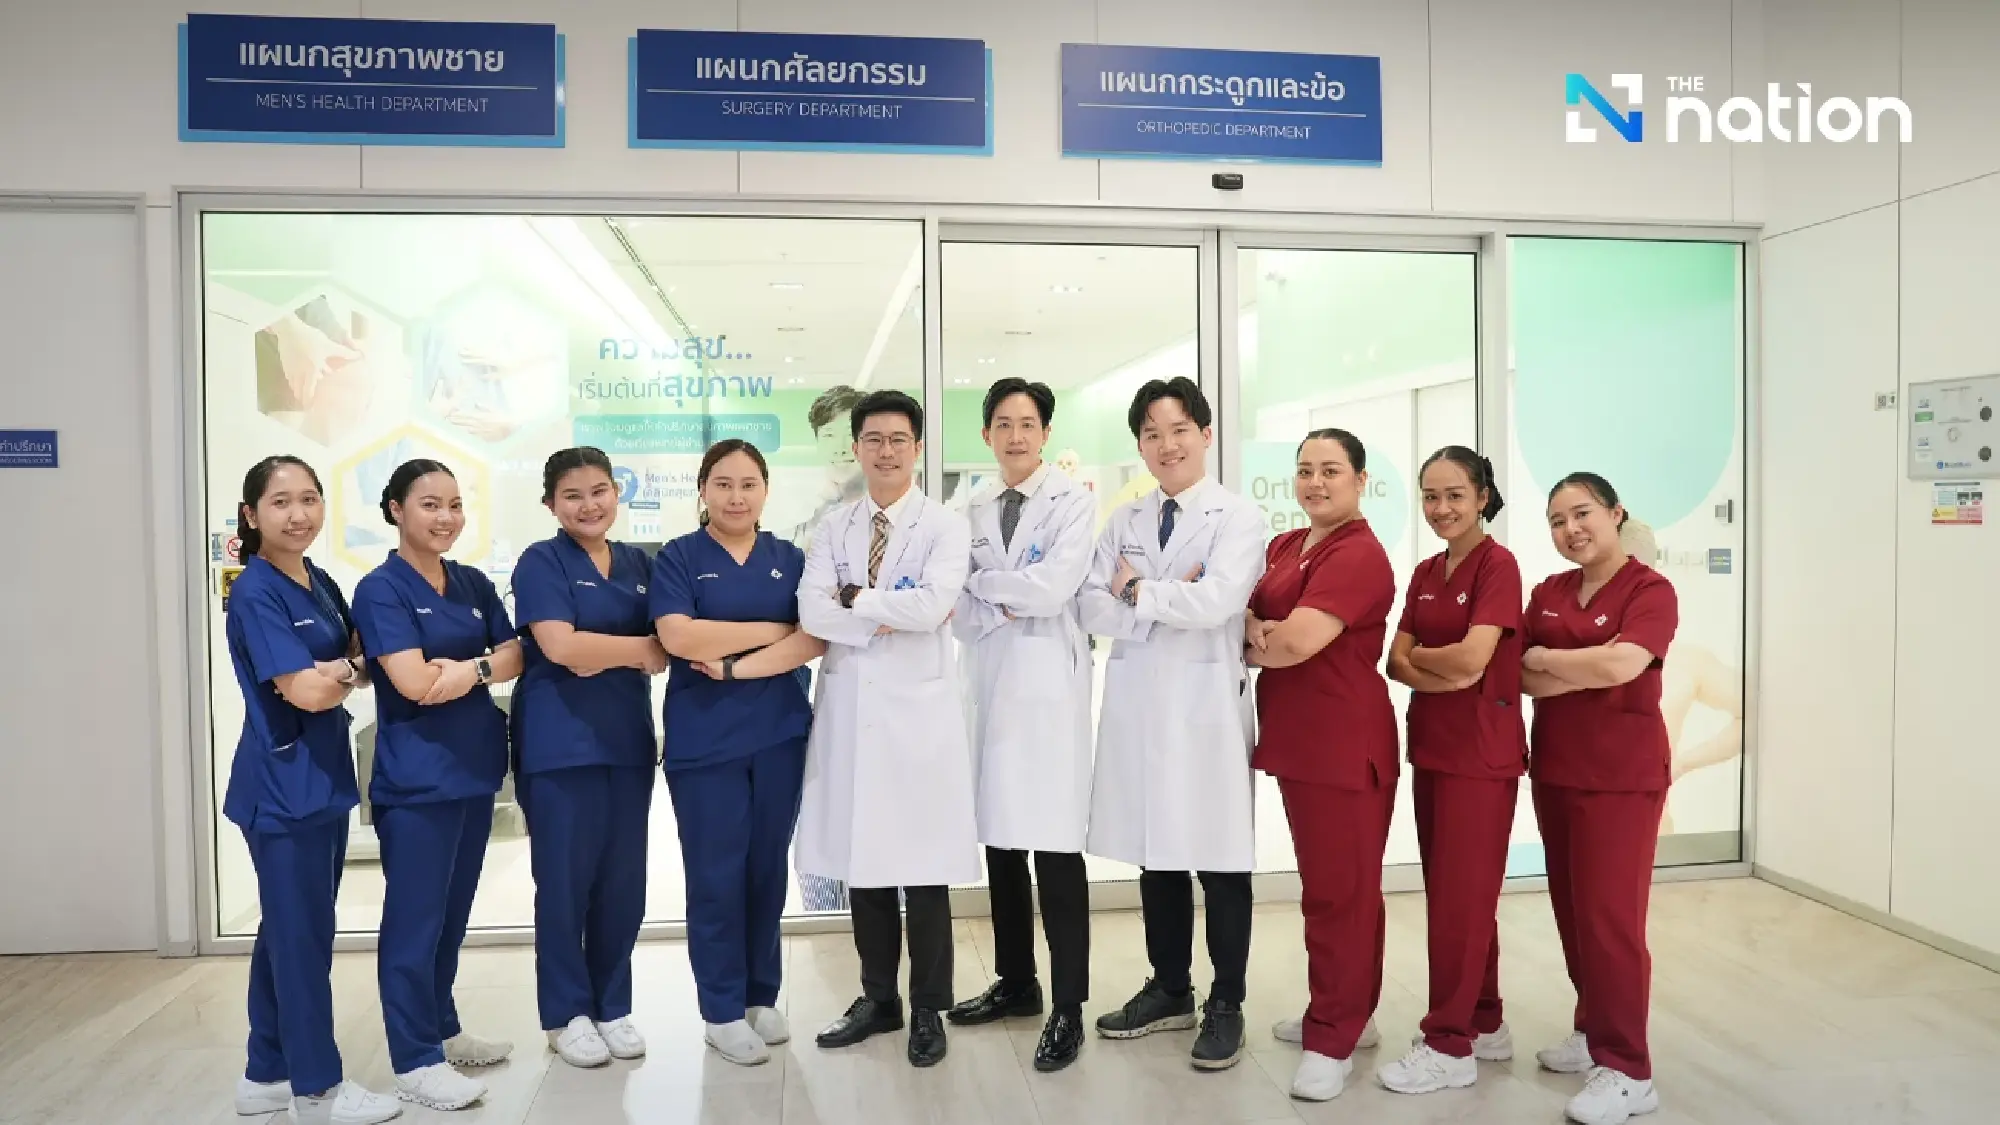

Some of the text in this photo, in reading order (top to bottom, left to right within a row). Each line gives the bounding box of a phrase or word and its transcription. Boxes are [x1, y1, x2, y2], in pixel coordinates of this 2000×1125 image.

[239, 42, 504, 78] แผนกสุขภาพชาย
[696, 52, 926, 86] แผนกศัลยกรรม
[1100, 71, 1345, 106] แผนกกระดูกและข้อ
[256, 93, 489, 113] MEN'S HEALTH DEPARTMENT
[721, 101, 903, 119] SURGERY DEPARTMENT
[1136, 120, 1312, 140] ORTHOPEDIC DEPARTMENT
